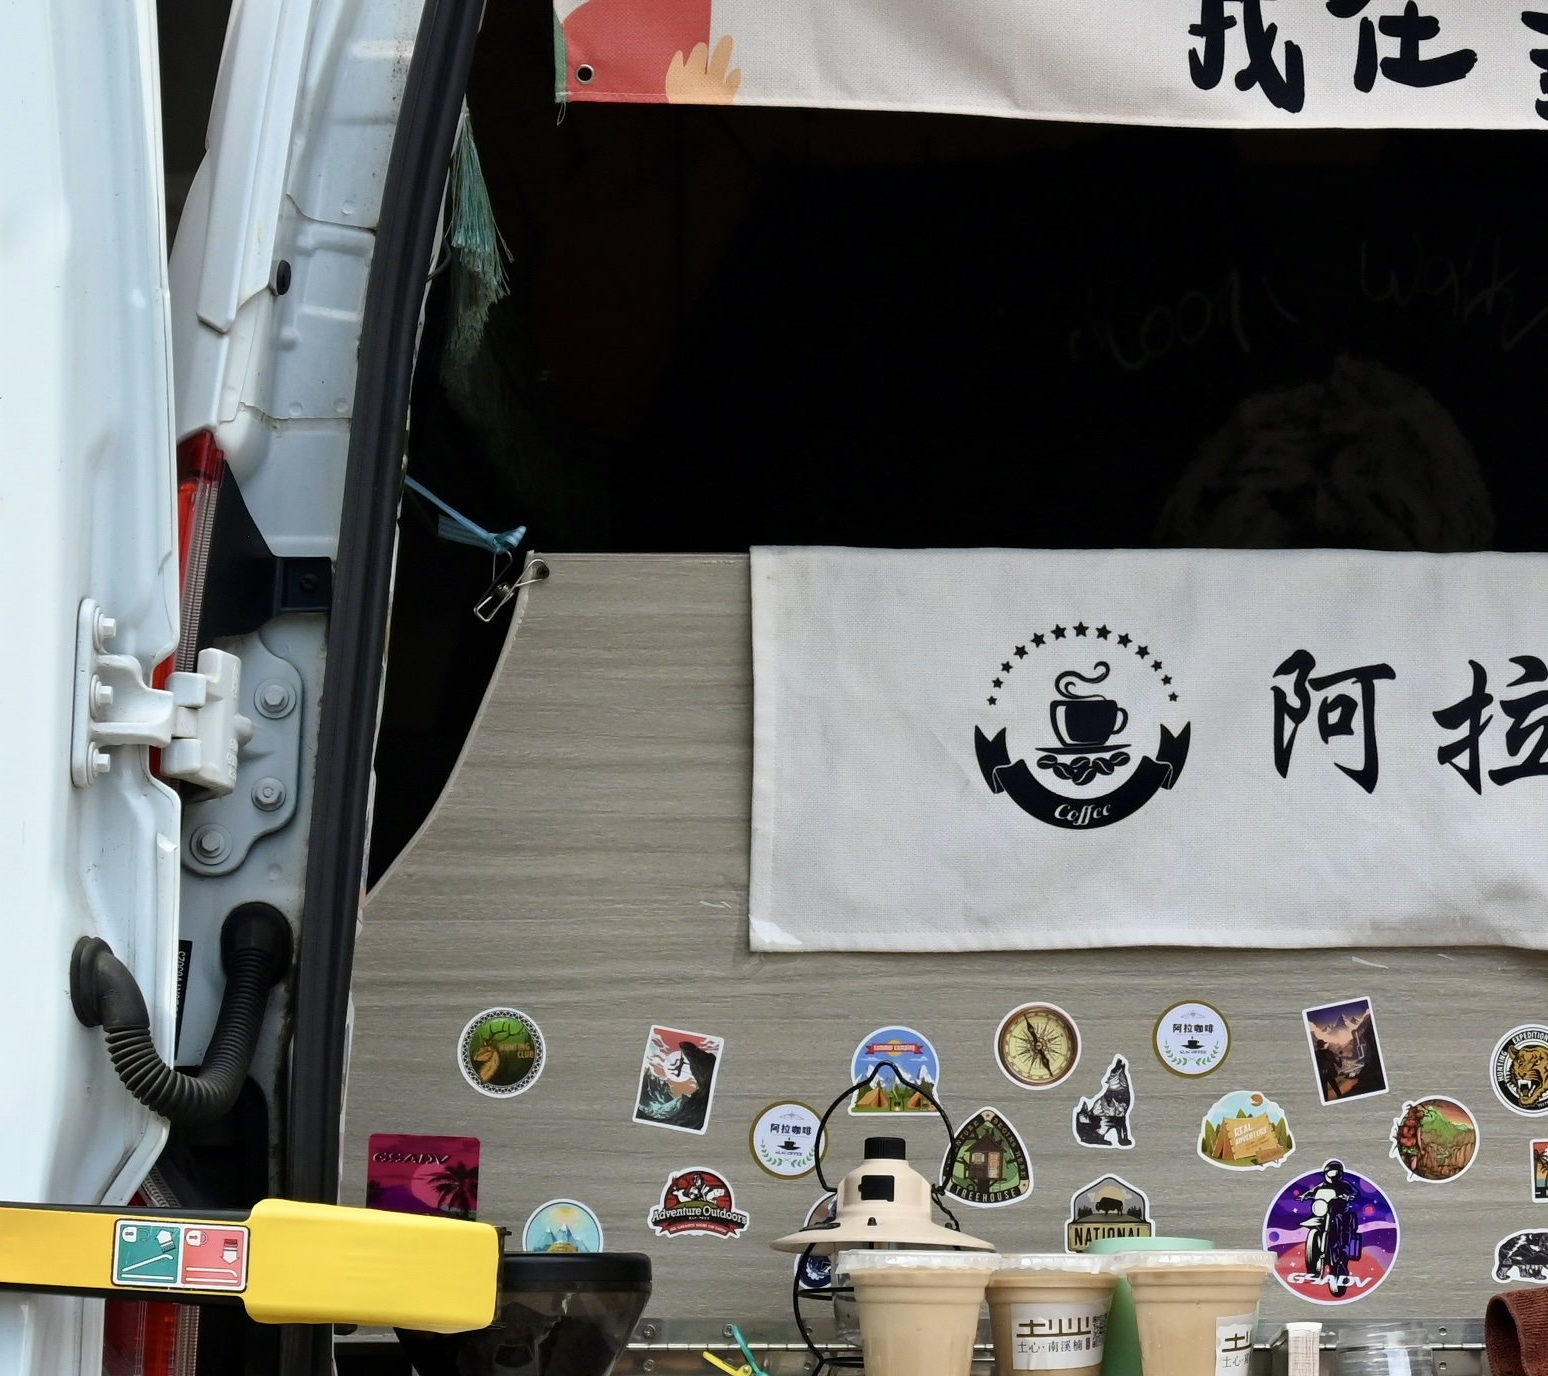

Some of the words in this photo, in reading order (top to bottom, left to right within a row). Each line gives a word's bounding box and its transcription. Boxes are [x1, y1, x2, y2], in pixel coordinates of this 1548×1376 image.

[1172, 1023, 1214, 1034] 阿拉咖啡
[1512, 1030, 1548, 1043] EXPEDITION
[1497, 1050, 1508, 1083] HUNTING
[770, 1123, 812, 1136] 阿拉咖啡
[954, 1186, 1016, 1203] TREEHOUSE
[652, 1207, 702, 1223] Adventure
[703, 1207, 748, 1224] Outdoors
